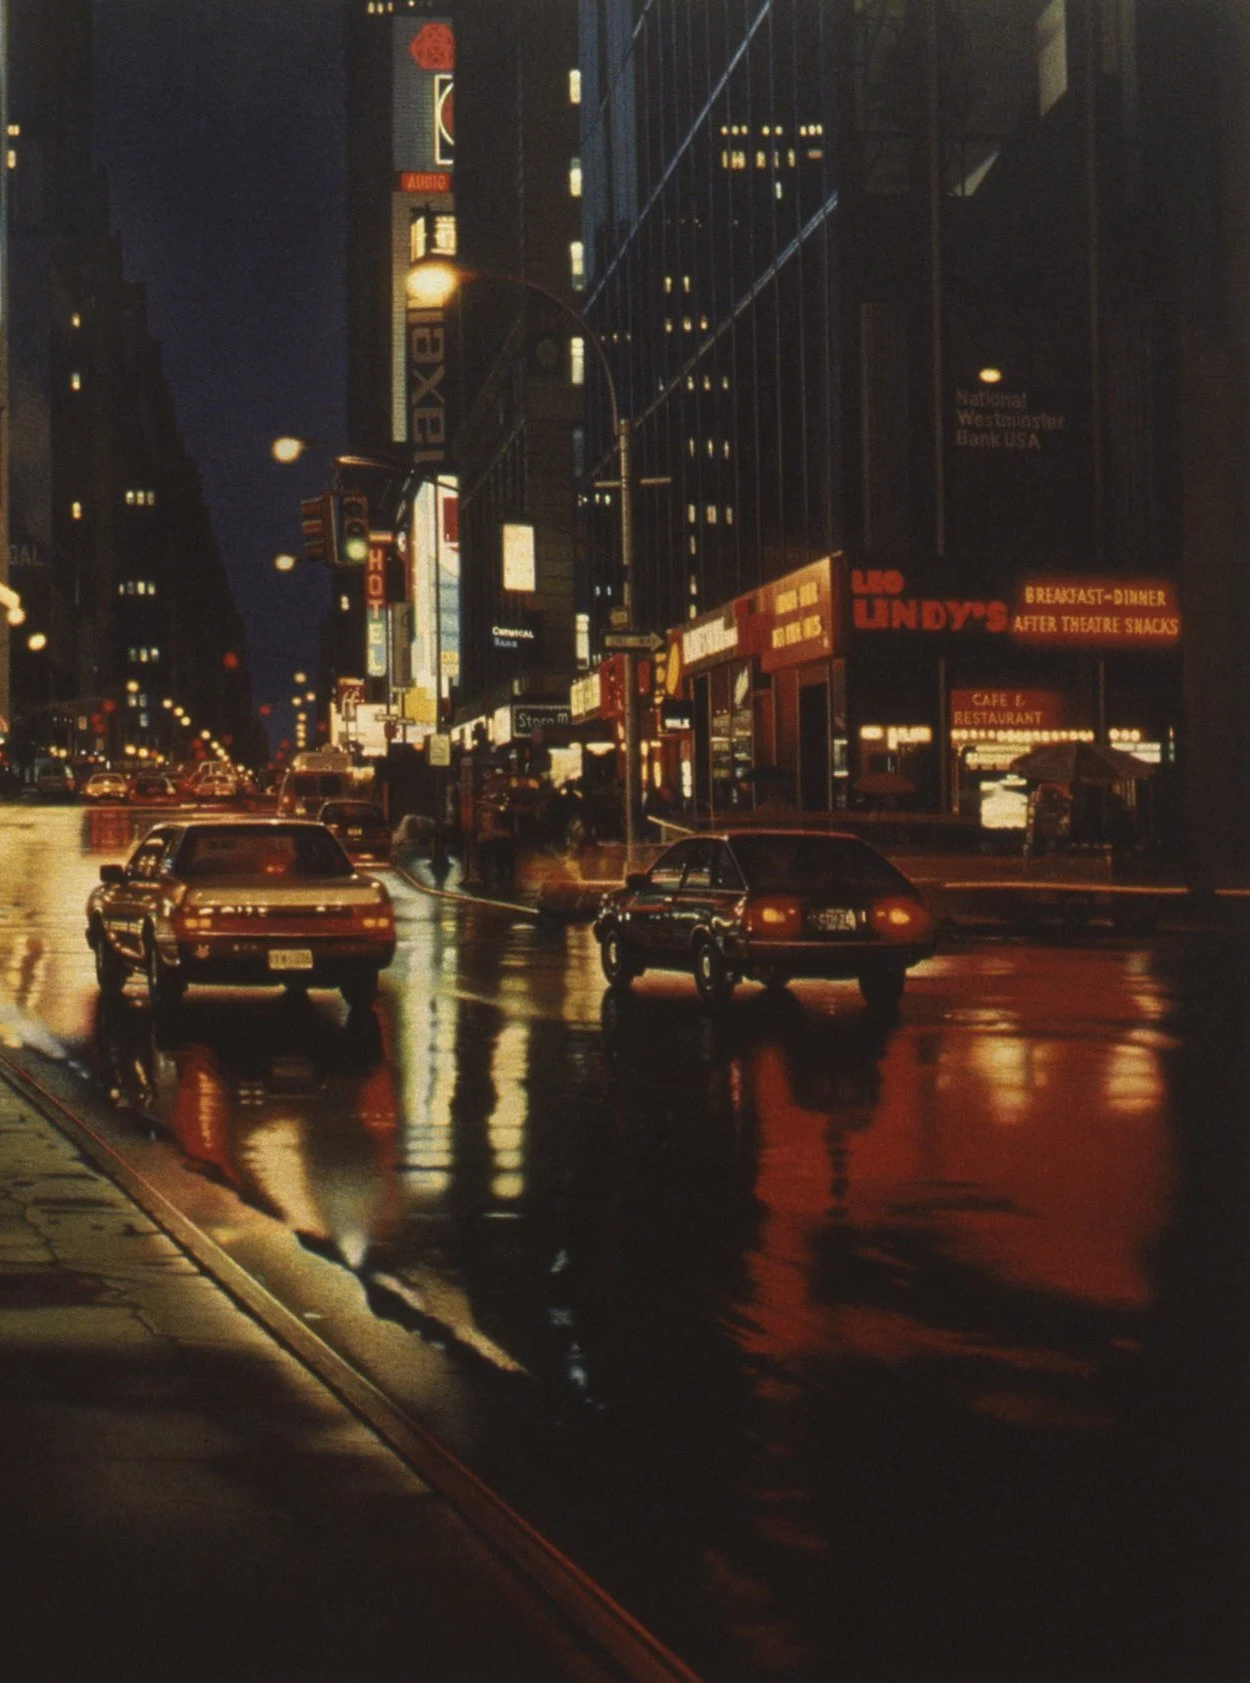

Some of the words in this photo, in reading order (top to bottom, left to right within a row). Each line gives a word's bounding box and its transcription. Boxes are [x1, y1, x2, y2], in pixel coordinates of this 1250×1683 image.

[956, 388, 1028, 408] National
[956, 408, 1065, 430] Westminster
[956, 428, 1000, 448] Bank
[1003, 431, 1041, 450] USA
[852, 568, 905, 595] LEO
[1024, 586, 1166, 607] BREAKFAST-DINNER
[368, 549, 384, 673] HOTEL
[1013, 616, 1057, 633] AFTER
[1061, 616, 1121, 635] THEATRE
[1125, 617, 1179, 636] SNACKS
[971, 693, 1008, 707] CAFE
[953, 711, 1043, 726] RESTAURANT
